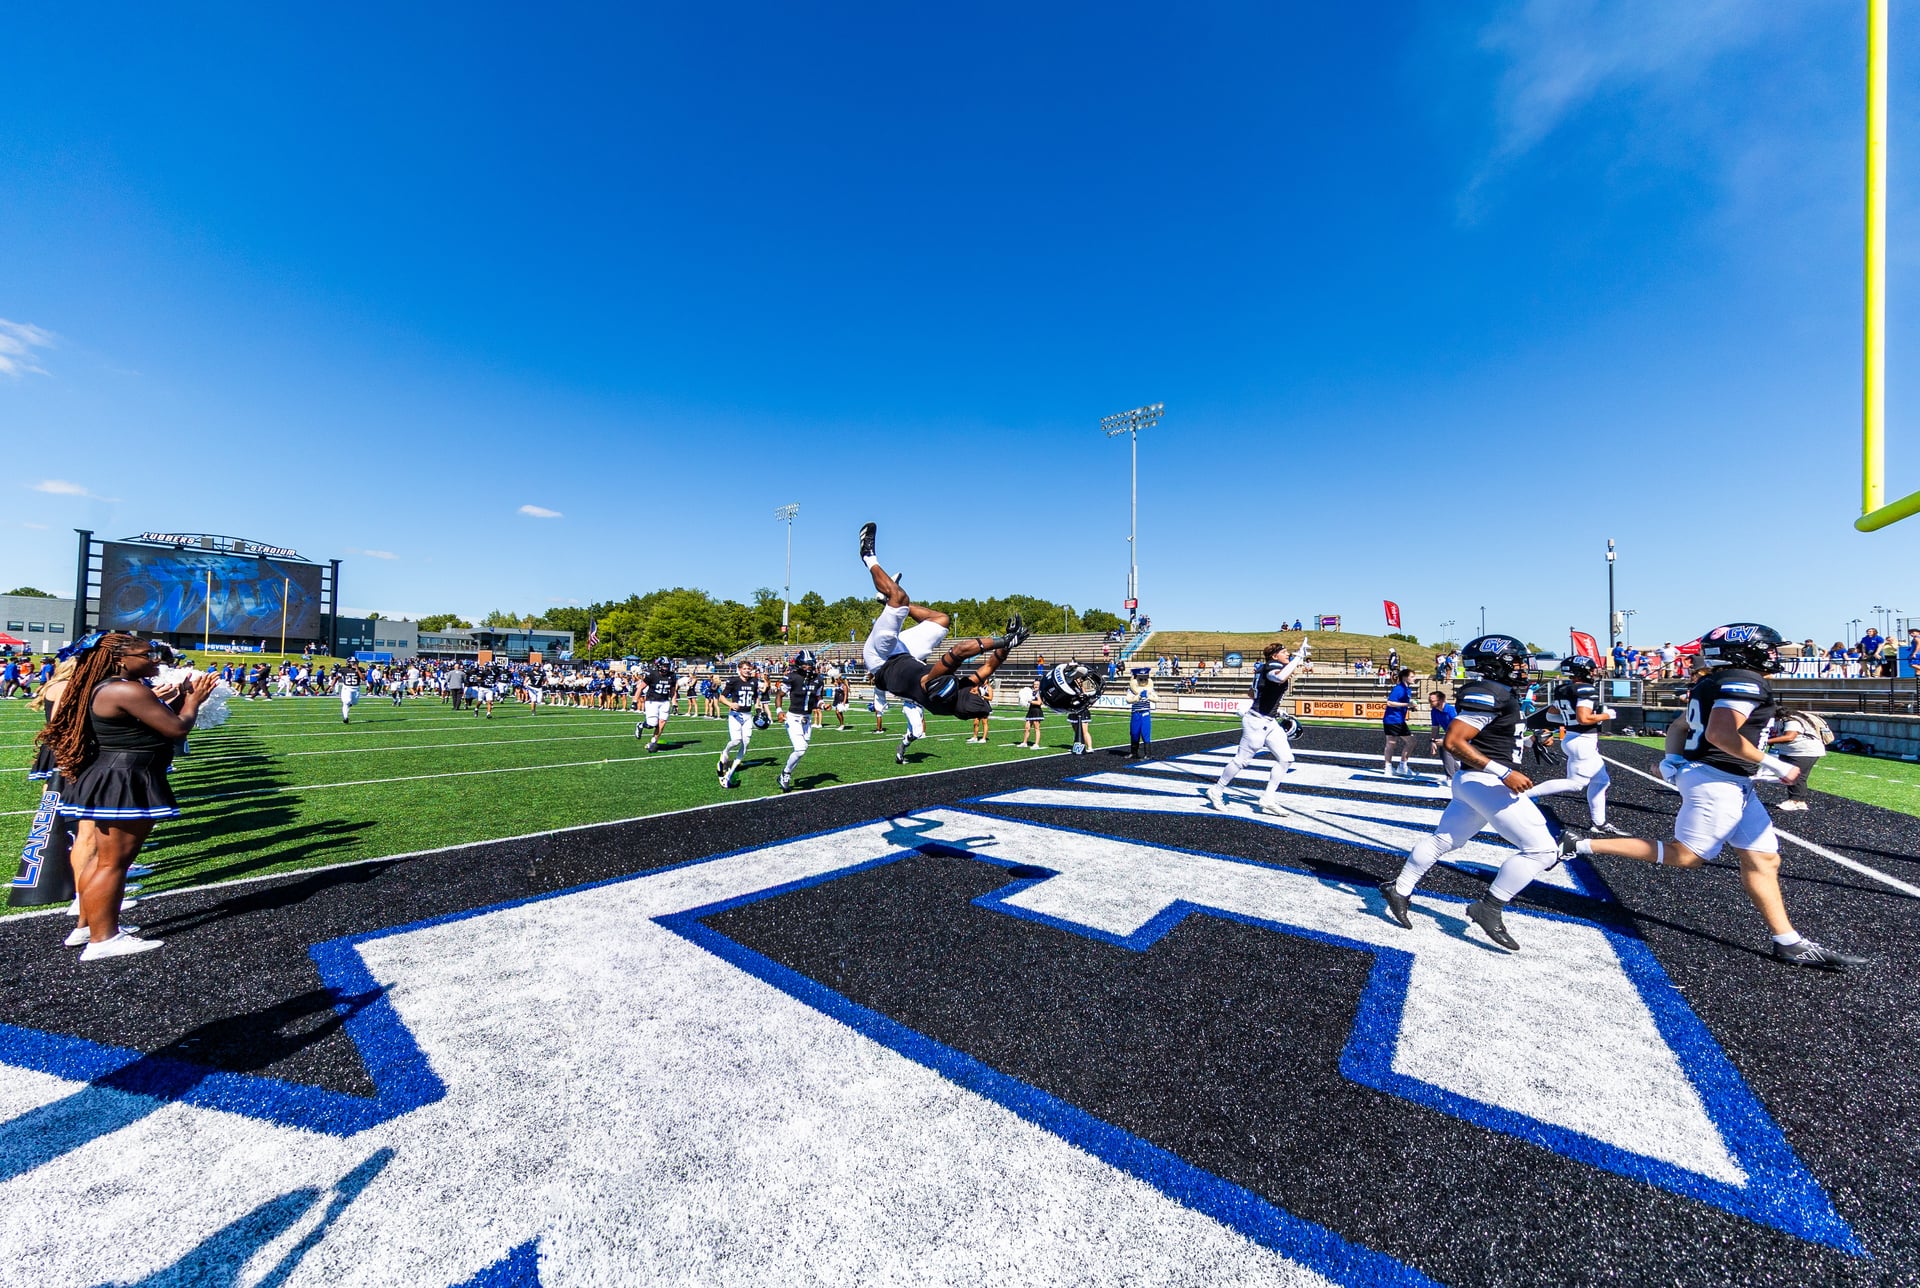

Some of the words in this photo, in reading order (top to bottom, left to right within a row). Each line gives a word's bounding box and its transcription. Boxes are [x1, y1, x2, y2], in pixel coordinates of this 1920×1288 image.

[142, 531, 195, 545] LUBBERS
[250, 544, 297, 557] STADIUM
[1725, 625, 1759, 642] GV
[1480, 637, 1511, 655] GV
[1098, 696, 1121, 706] PNC
[1203, 698, 1239, 712] meijer
[1303, 702, 1312, 714] B
[1355, 704, 1364, 716] B
[13, 790, 61, 888] LAKERS
